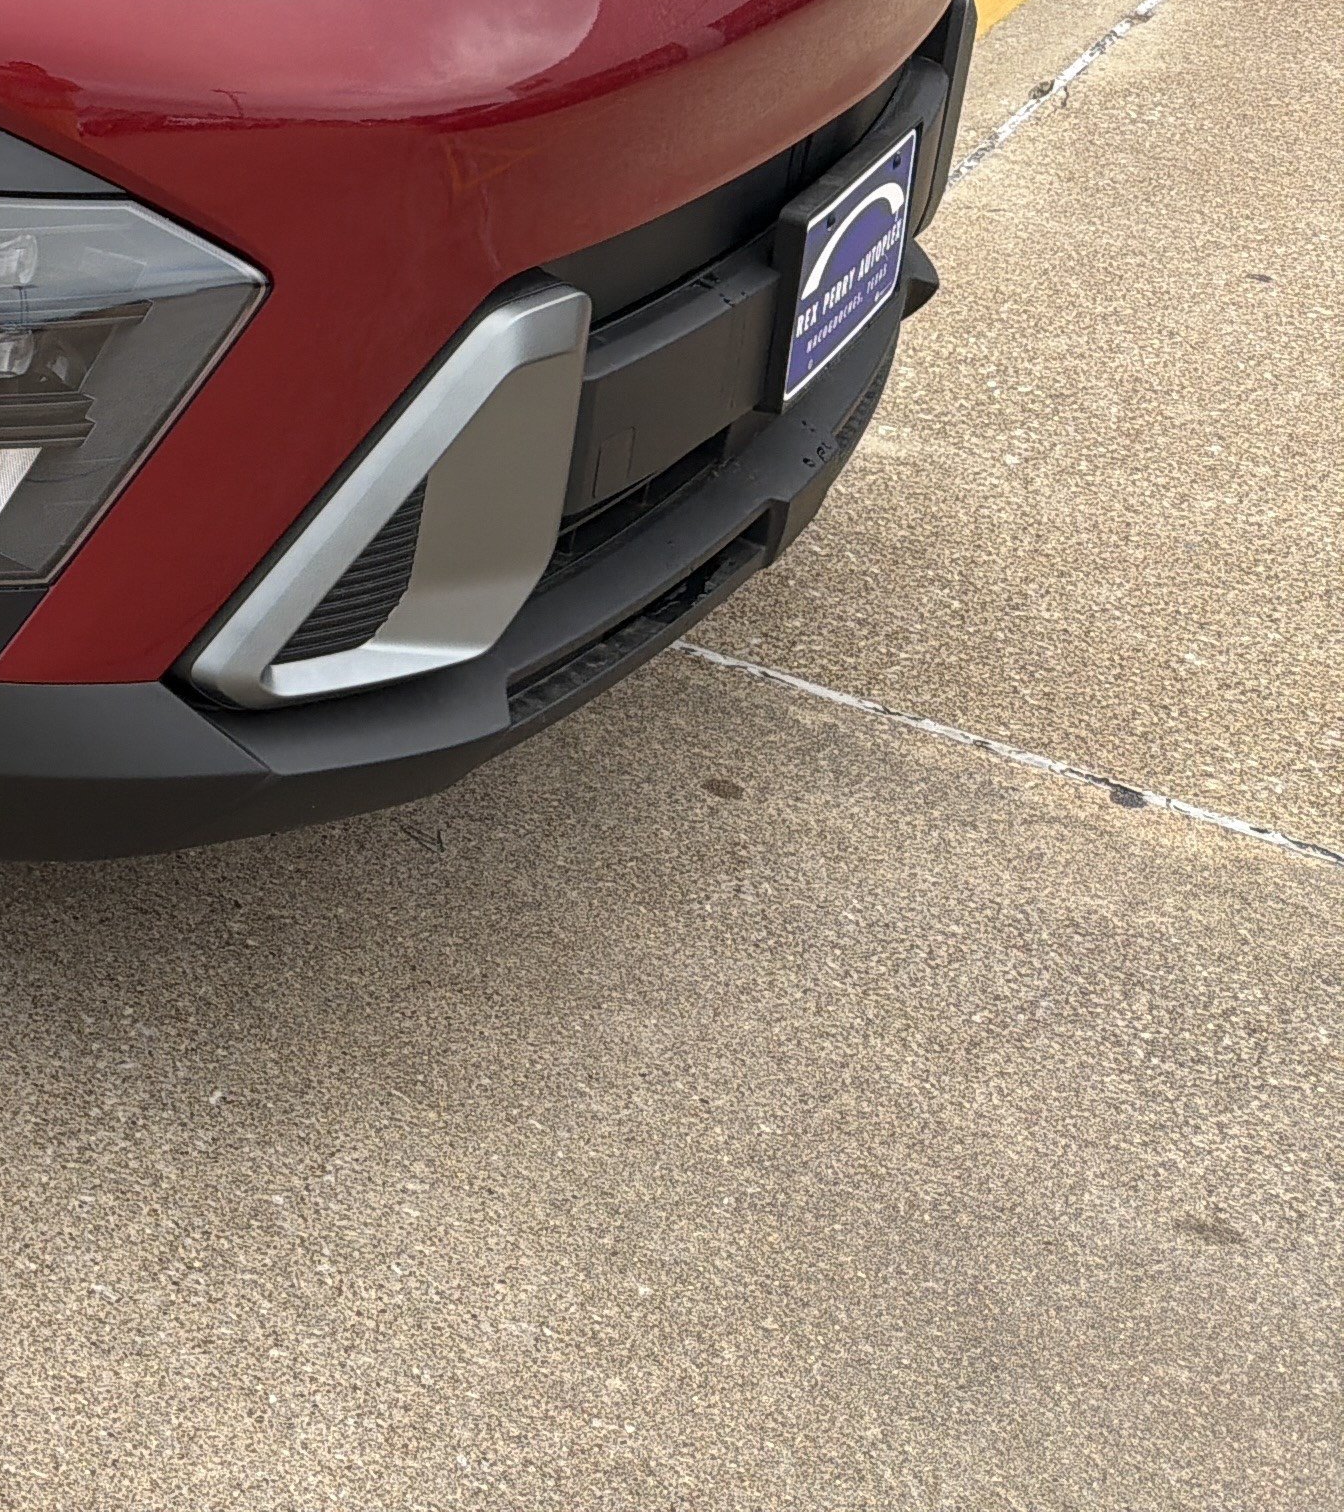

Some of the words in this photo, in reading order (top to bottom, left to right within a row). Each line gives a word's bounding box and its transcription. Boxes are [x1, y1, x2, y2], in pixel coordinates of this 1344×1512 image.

[795, 301, 820, 338] REX
[822, 266, 856, 316] PERRY
[857, 218, 903, 282] AUTOPLEX
[866, 263, 888, 294] TEXAS
